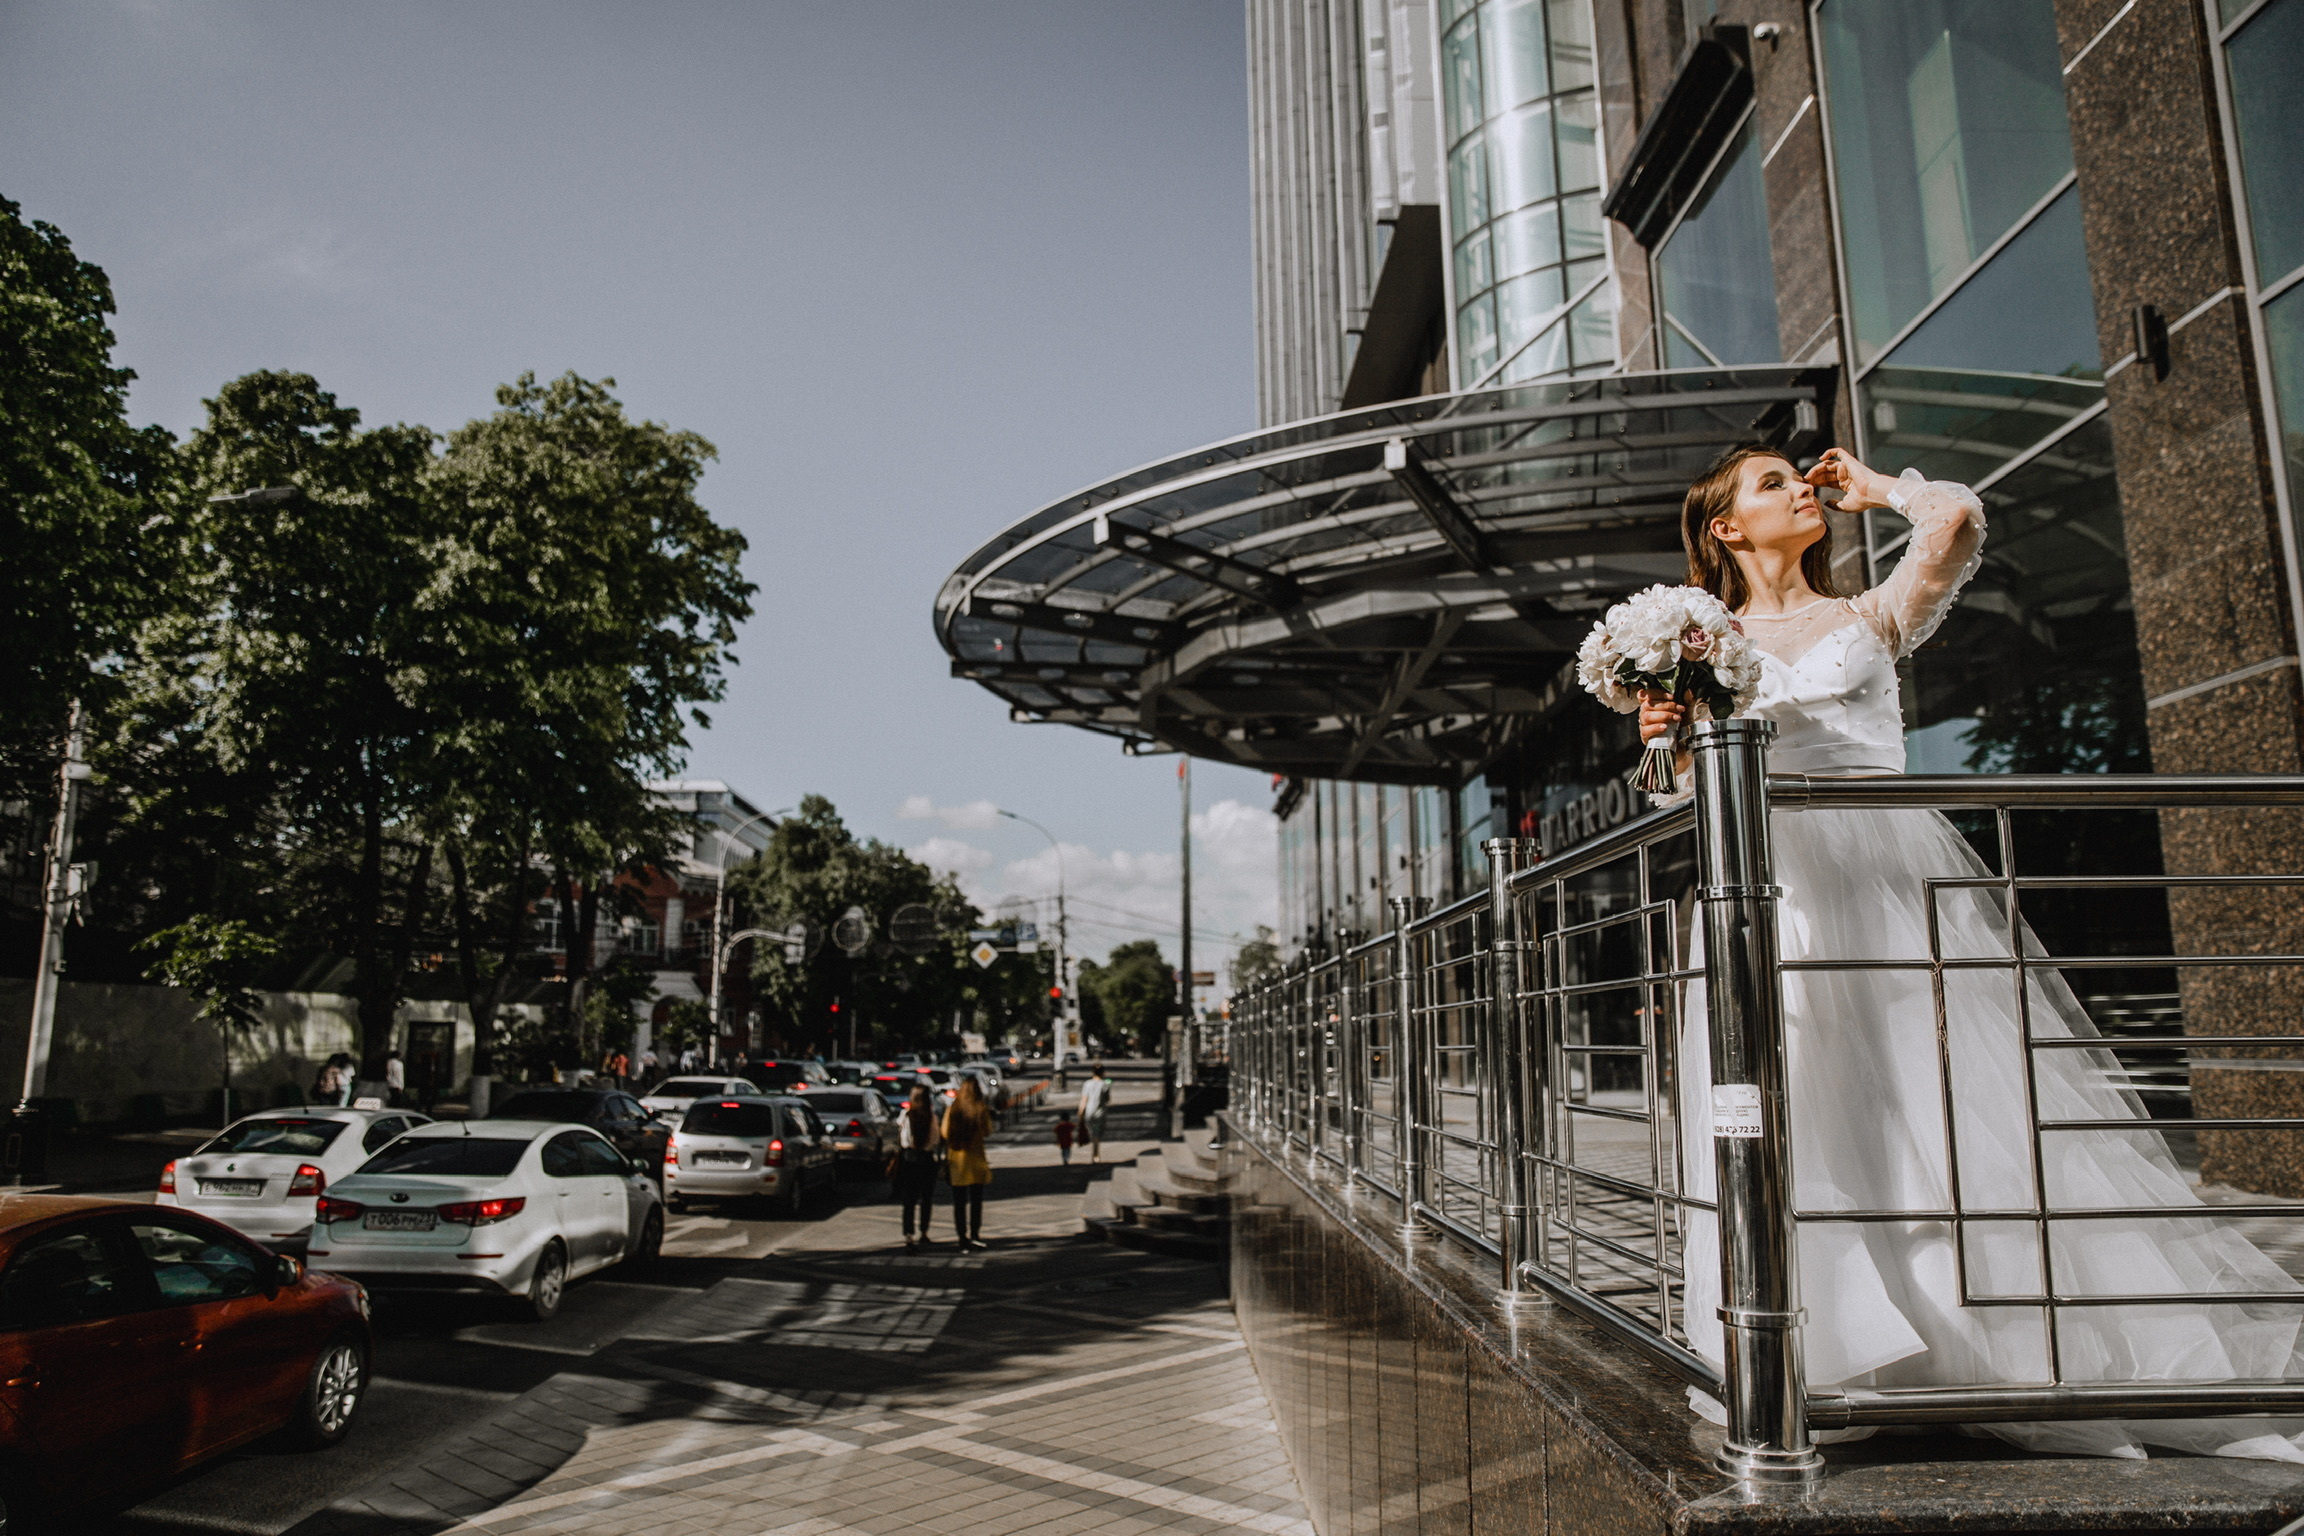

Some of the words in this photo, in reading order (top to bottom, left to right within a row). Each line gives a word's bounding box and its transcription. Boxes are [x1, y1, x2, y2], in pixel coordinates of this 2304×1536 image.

[1539, 767, 1653, 858] MARRIOT
[1739, 1125, 1749, 1133] 72
[1750, 1125, 1761, 1133] 22
